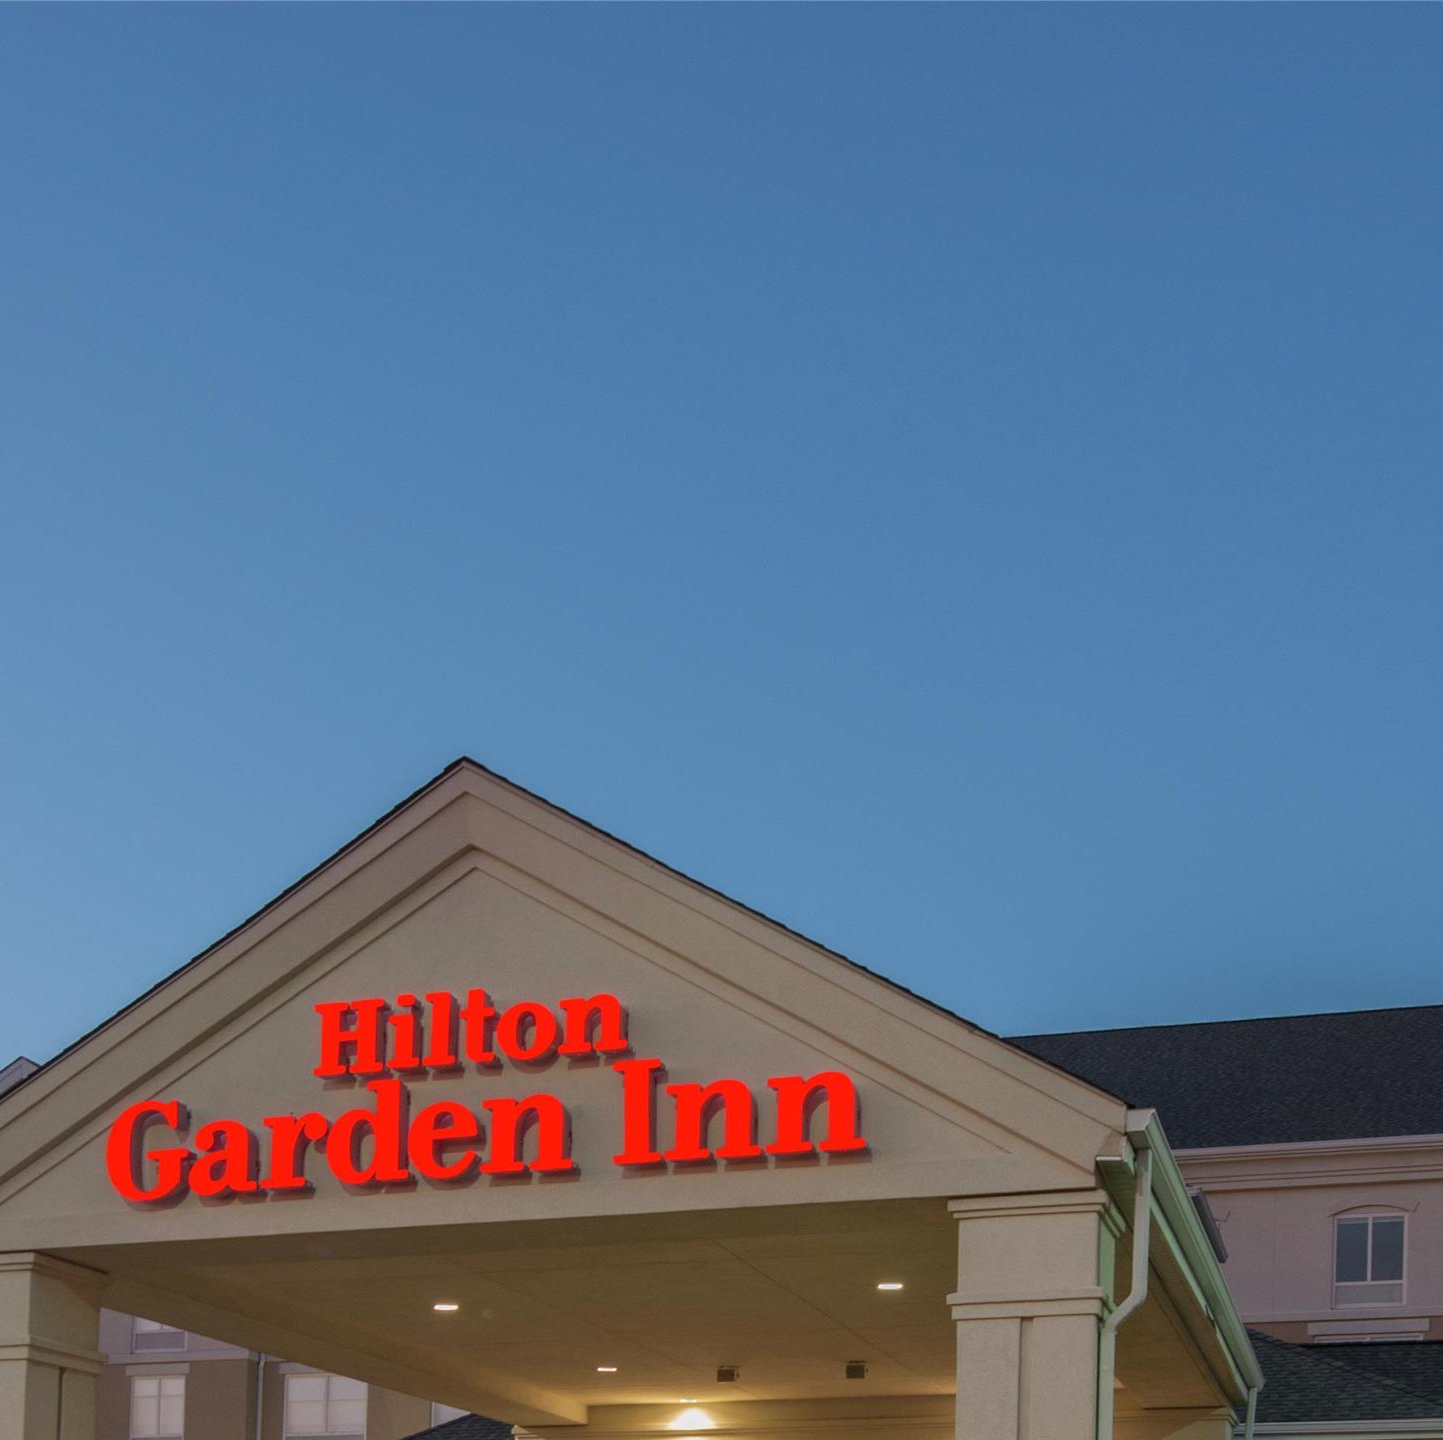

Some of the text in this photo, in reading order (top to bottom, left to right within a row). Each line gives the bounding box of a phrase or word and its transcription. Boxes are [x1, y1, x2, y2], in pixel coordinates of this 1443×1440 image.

[312, 987, 629, 1078] Hilton
[105, 1057, 868, 1203] Garden Inn
